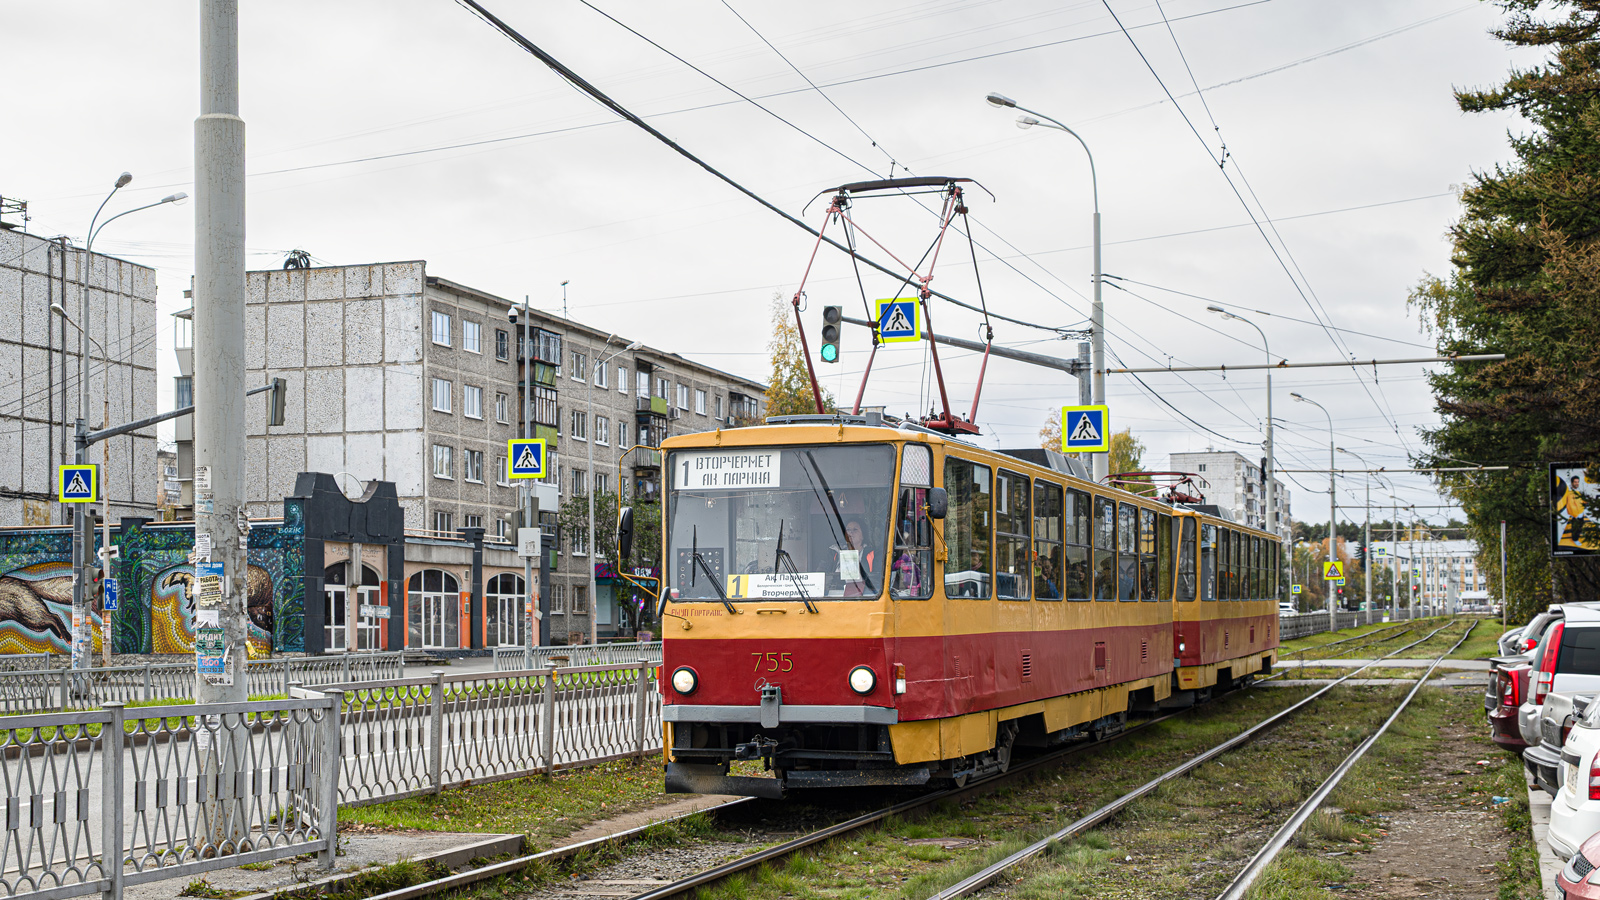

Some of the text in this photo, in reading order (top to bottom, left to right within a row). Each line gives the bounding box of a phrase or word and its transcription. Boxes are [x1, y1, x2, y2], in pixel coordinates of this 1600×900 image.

[696, 455, 772, 469] ВТОРЧЕРМЕТ
[682, 461, 689, 486] 1
[724, 472, 770, 485] ПАРИНА
[780, 574, 808, 582] Парина
[731, 575, 743, 598] 1
[762, 589, 809, 598] Вторчермет
[198, 633, 223, 641] КРЕДИТ
[201, 659, 220, 667] 1500
[751, 652, 793, 672] 755
